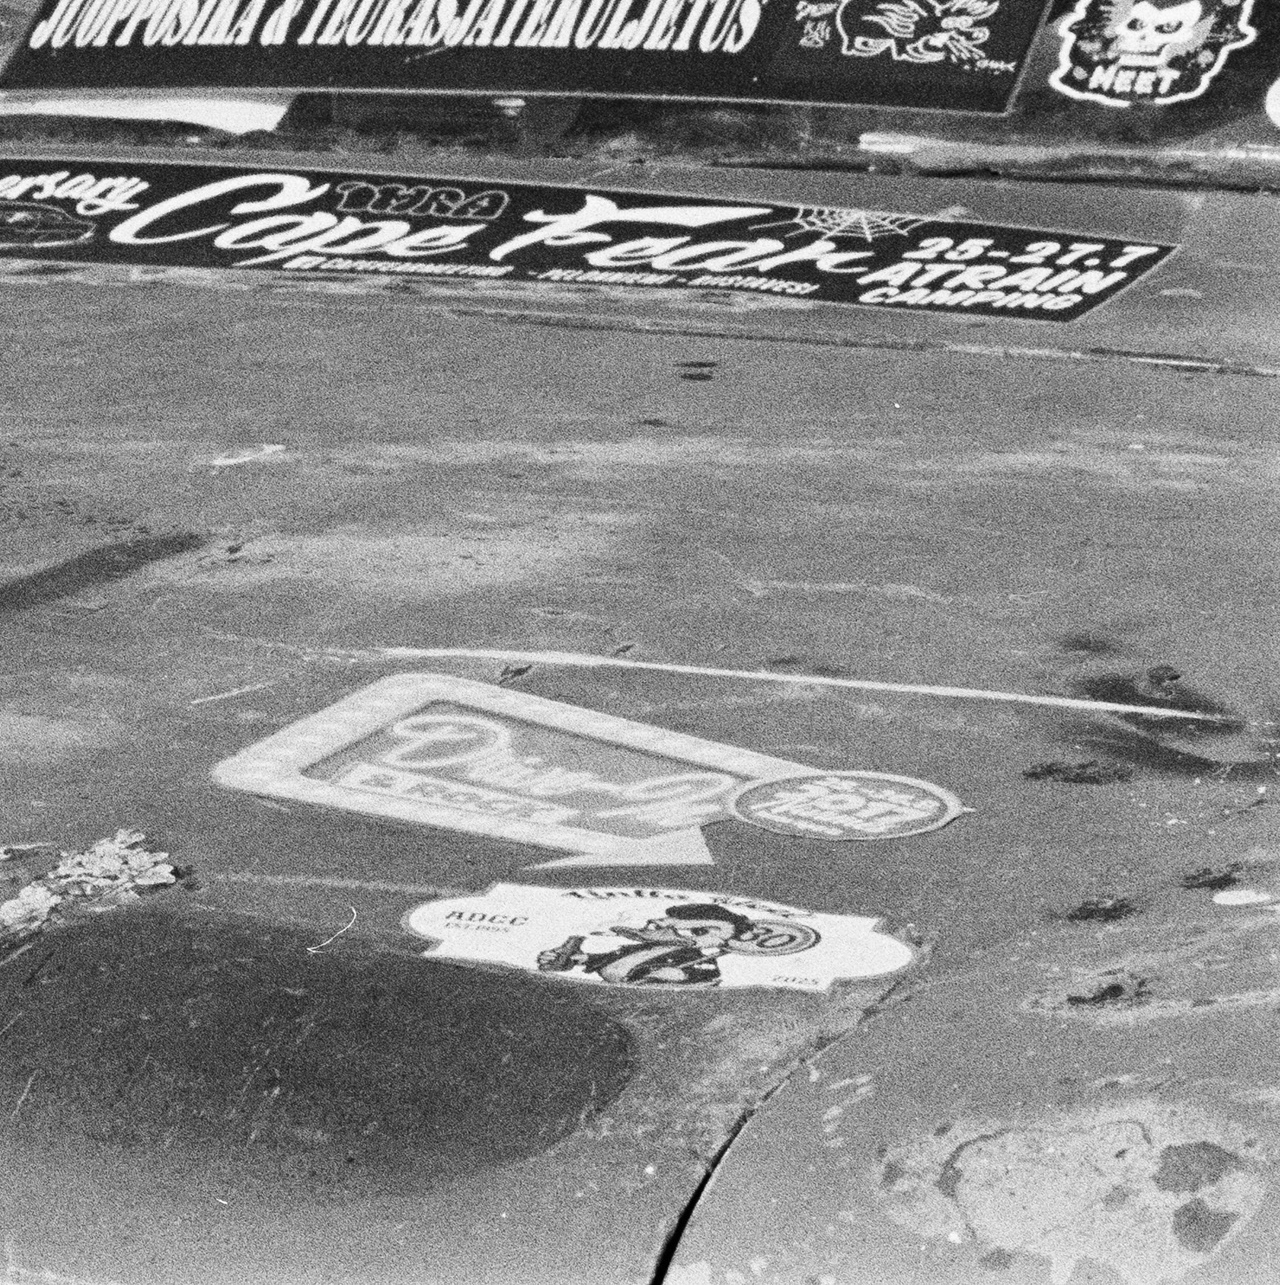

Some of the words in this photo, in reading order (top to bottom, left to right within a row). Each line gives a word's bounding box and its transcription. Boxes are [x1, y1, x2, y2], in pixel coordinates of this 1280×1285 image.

[1087, 64, 1182, 96] MEET
[109, 172, 488, 267] Cape
[489, 194, 876, 276] Fear
[855, 260, 1128, 295] ATRAIN
[857, 285, 1083, 312] CAMPING
